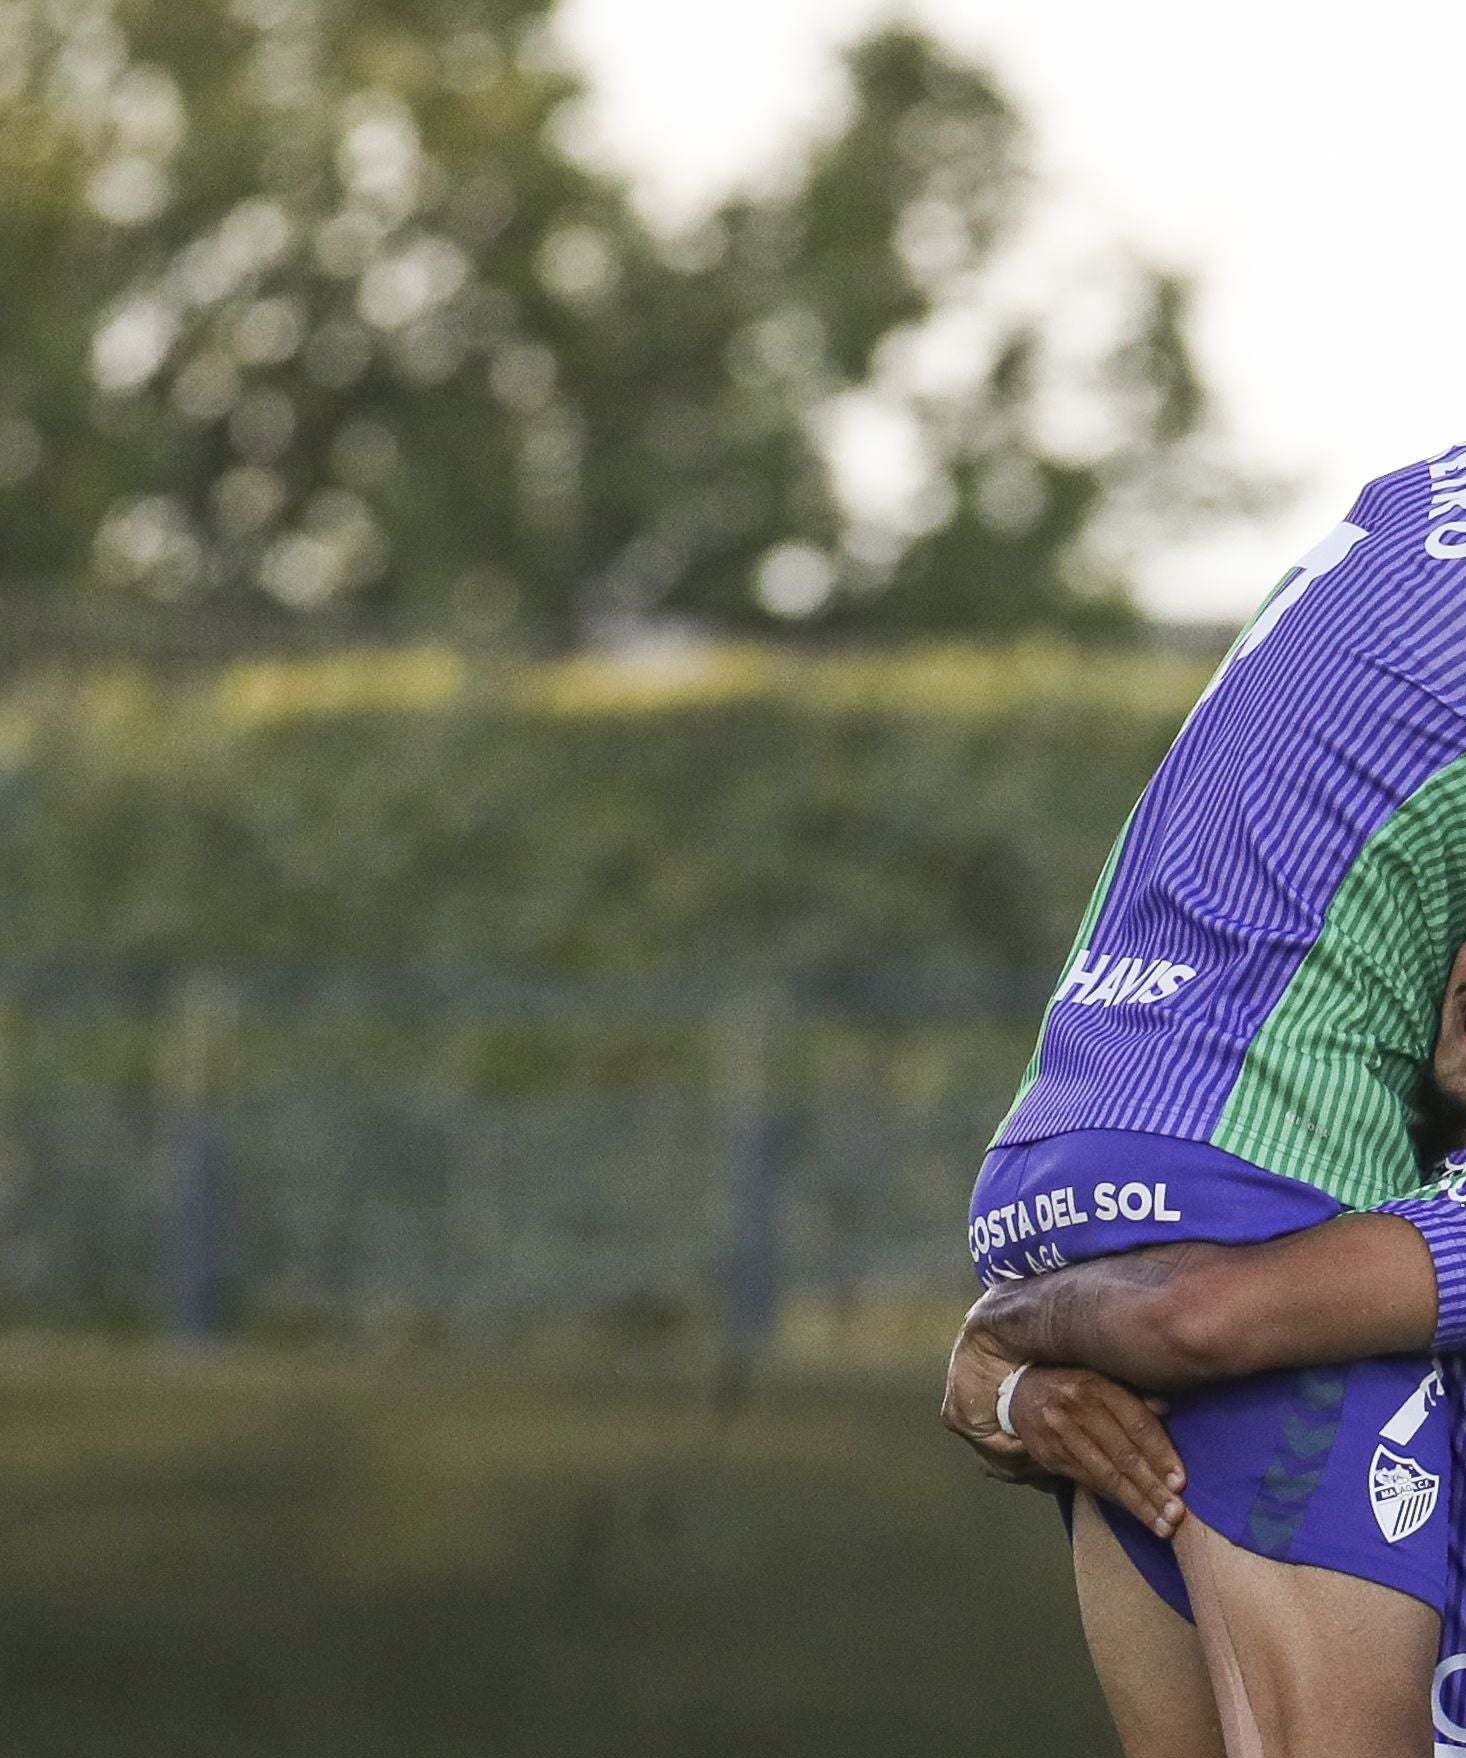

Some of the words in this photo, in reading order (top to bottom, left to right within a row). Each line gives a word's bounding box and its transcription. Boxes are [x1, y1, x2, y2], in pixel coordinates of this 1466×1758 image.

[968, 1200, 1037, 1262] COSTA
[1035, 1186, 1089, 1232] DEL
[1093, 1182, 1181, 1222] SOL
